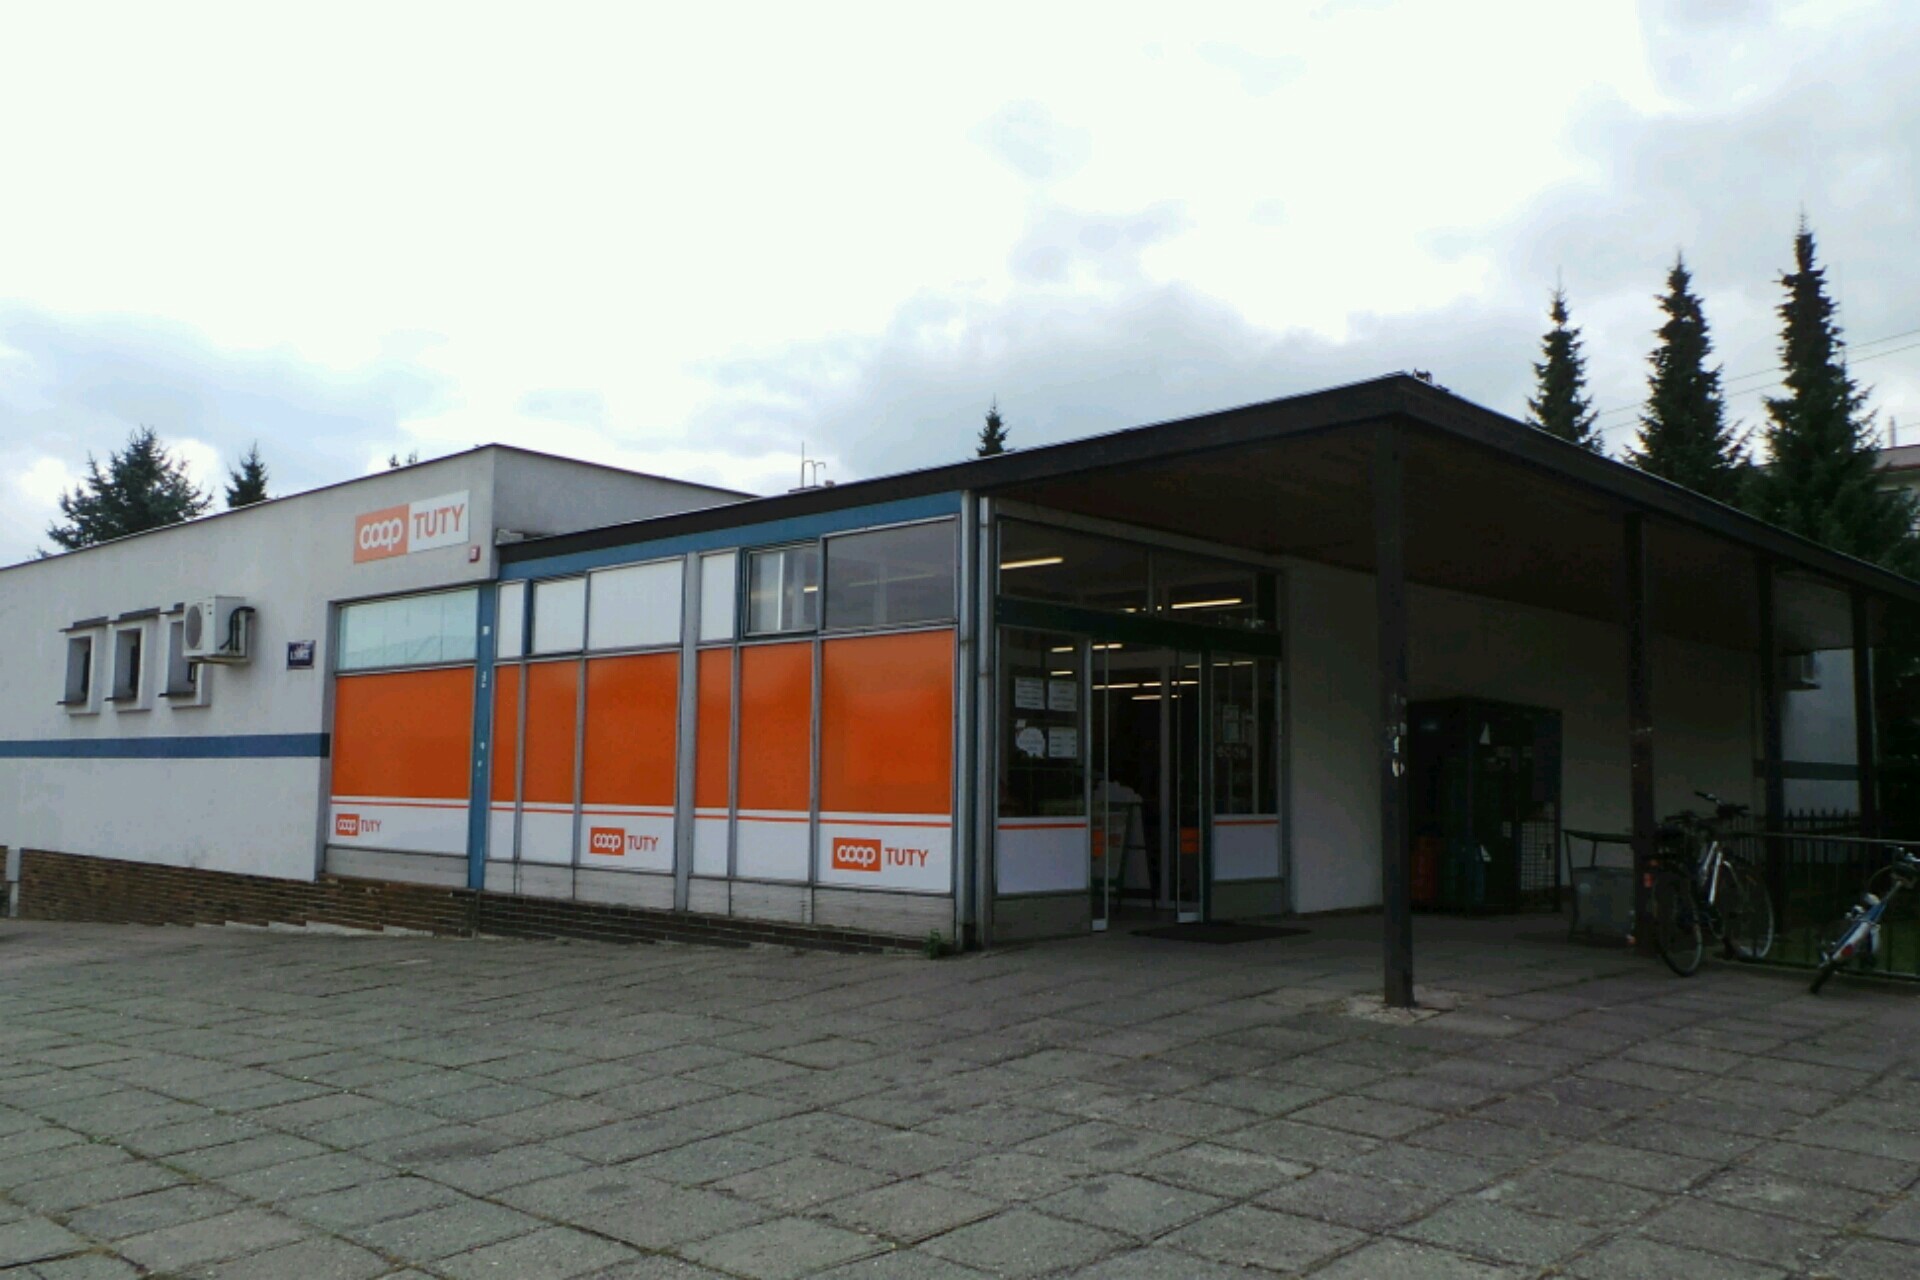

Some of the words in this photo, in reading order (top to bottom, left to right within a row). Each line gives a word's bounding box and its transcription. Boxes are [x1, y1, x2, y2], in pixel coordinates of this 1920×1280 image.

[360, 518, 403, 551] coop
[414, 504, 464, 540] TUTY
[361, 819, 382, 832] TUTY
[593, 834, 621, 852] coop
[628, 835, 659, 851] TUTY
[837, 845, 876, 868] coop
[885, 847, 928, 867] TUTY
